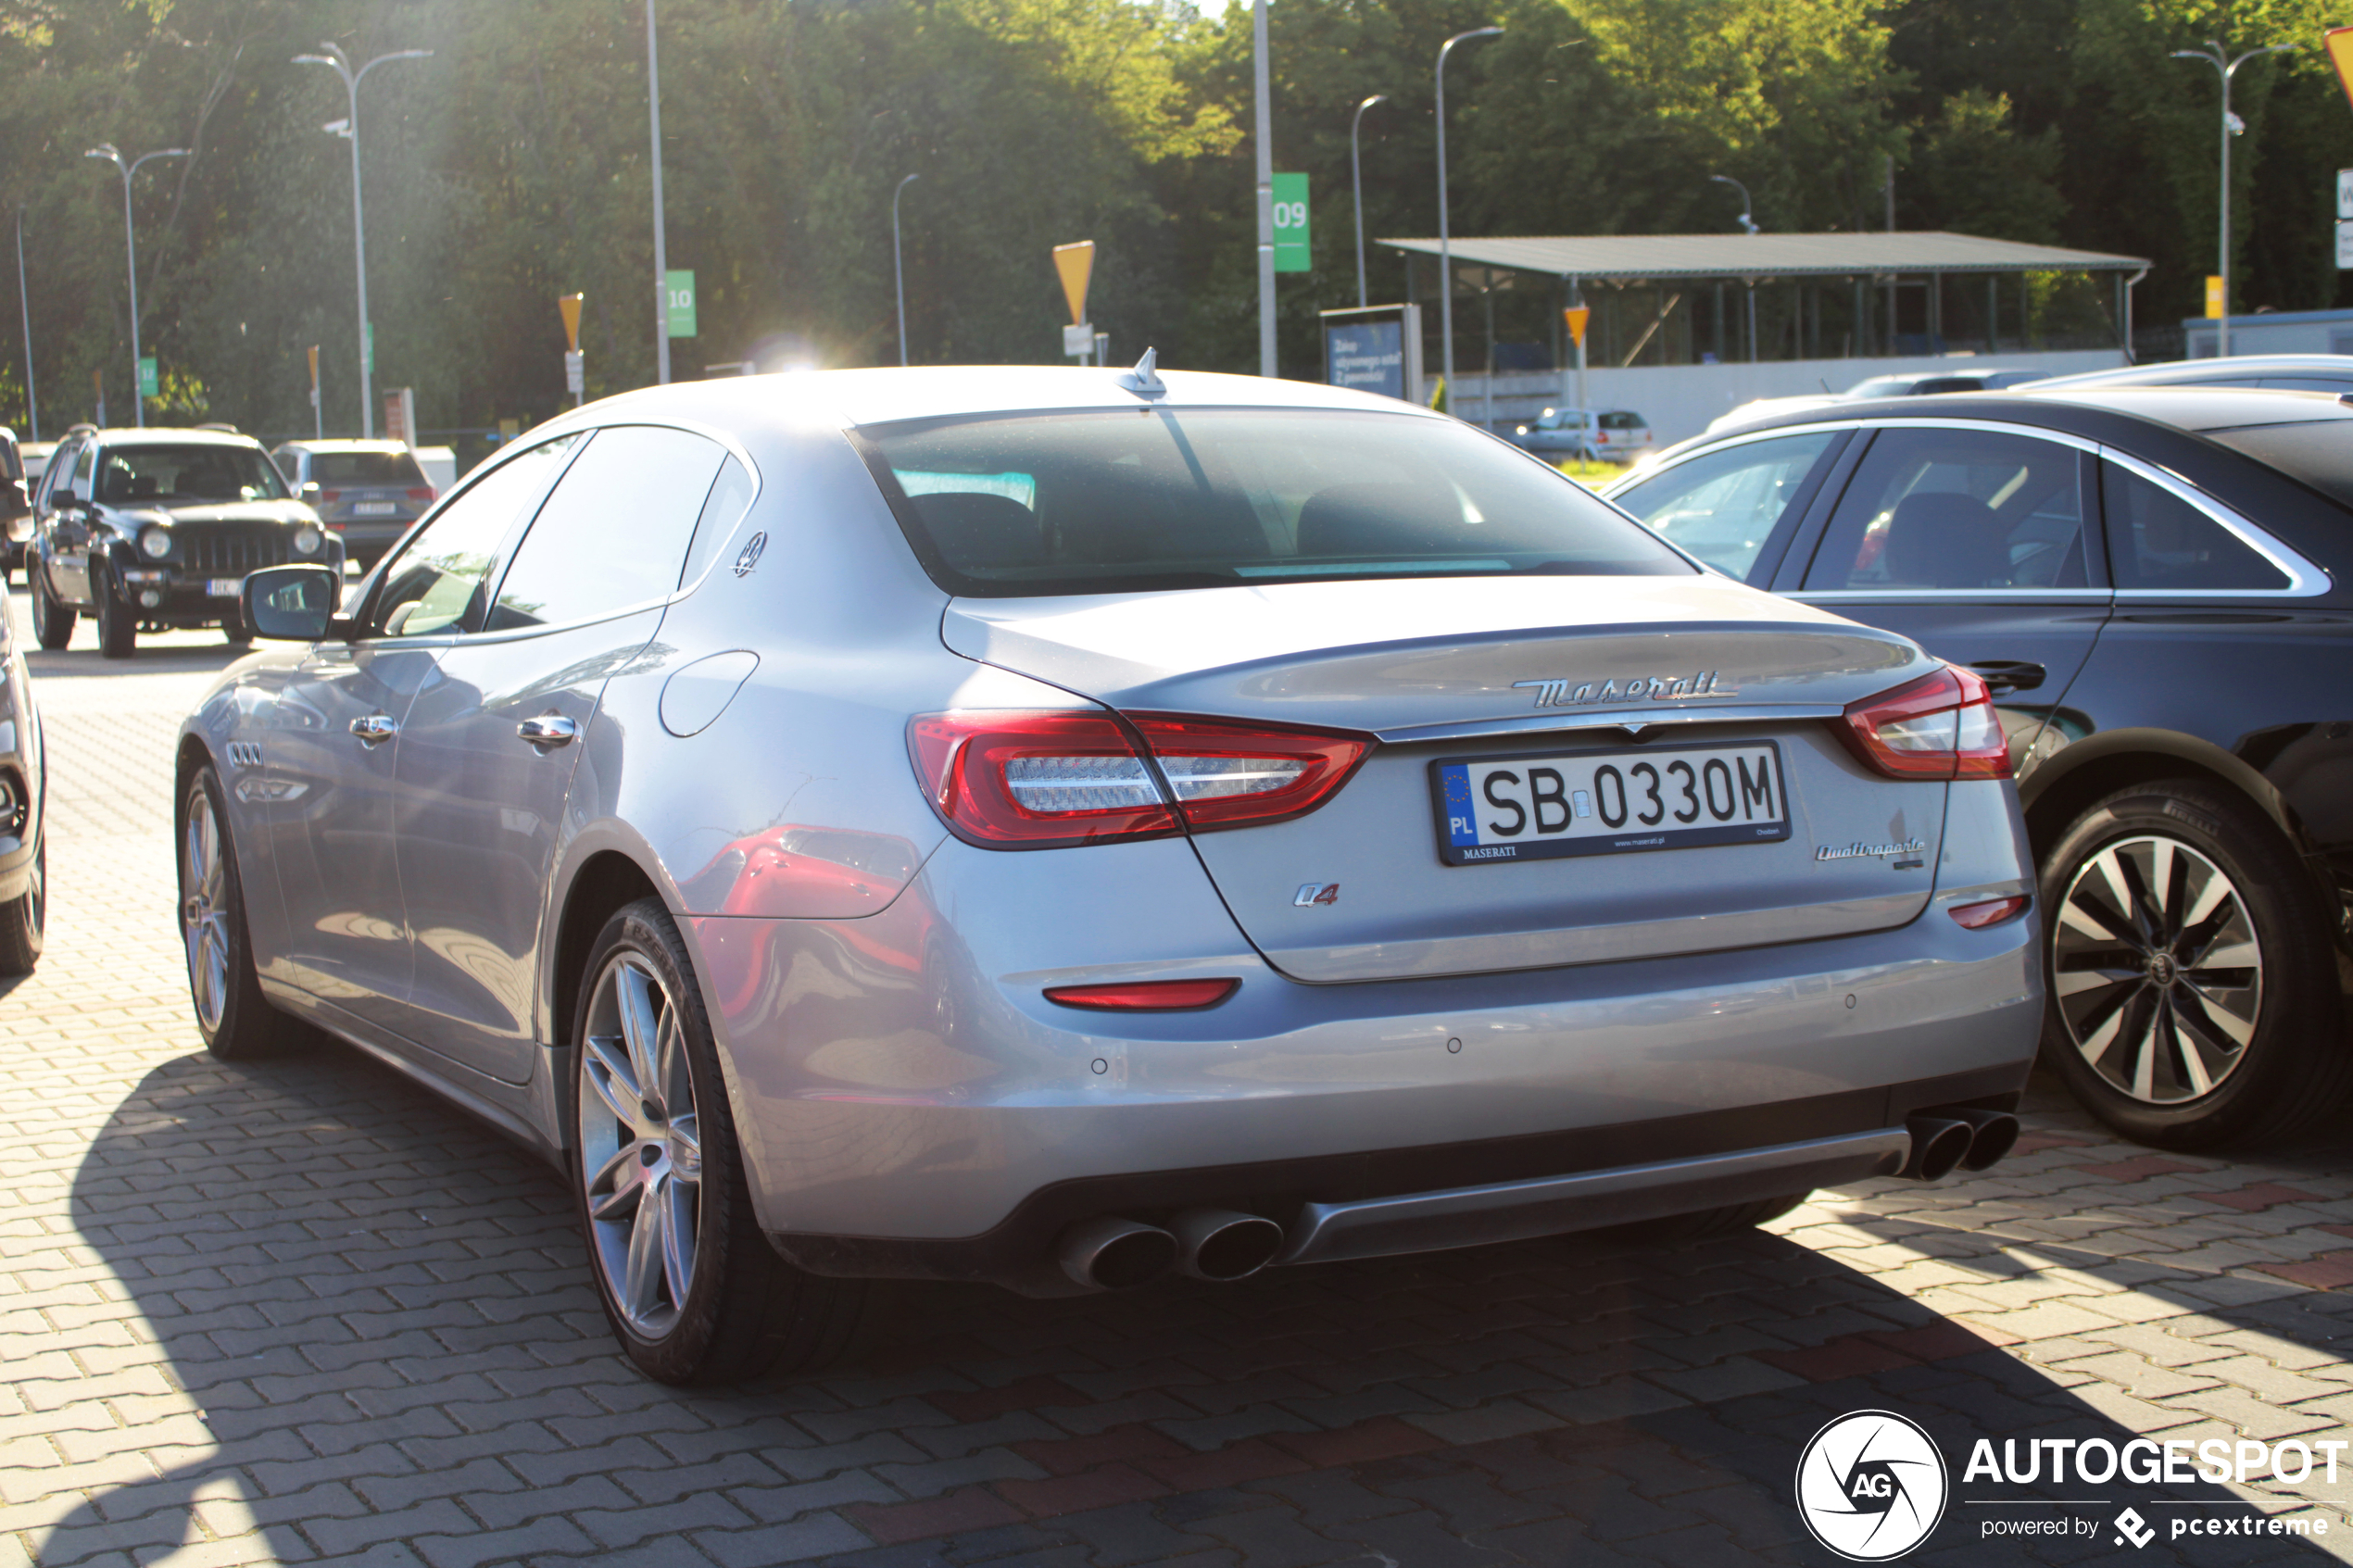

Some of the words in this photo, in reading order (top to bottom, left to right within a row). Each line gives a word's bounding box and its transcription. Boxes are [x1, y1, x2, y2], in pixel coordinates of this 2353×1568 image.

[1274, 202, 1306, 228] 09
[670, 290, 692, 308] 10
[1512, 671, 1739, 708] Maserati
[1483, 768, 1573, 836] SB
[1594, 756, 1776, 829] 0330M
[1450, 817, 1474, 835] PL
[1463, 847, 1516, 859] MASERATI
[1615, 837, 1666, 847] www.maserati.pl
[1816, 837, 1926, 860] Quattroporte
[1293, 883, 1340, 908] Q4
